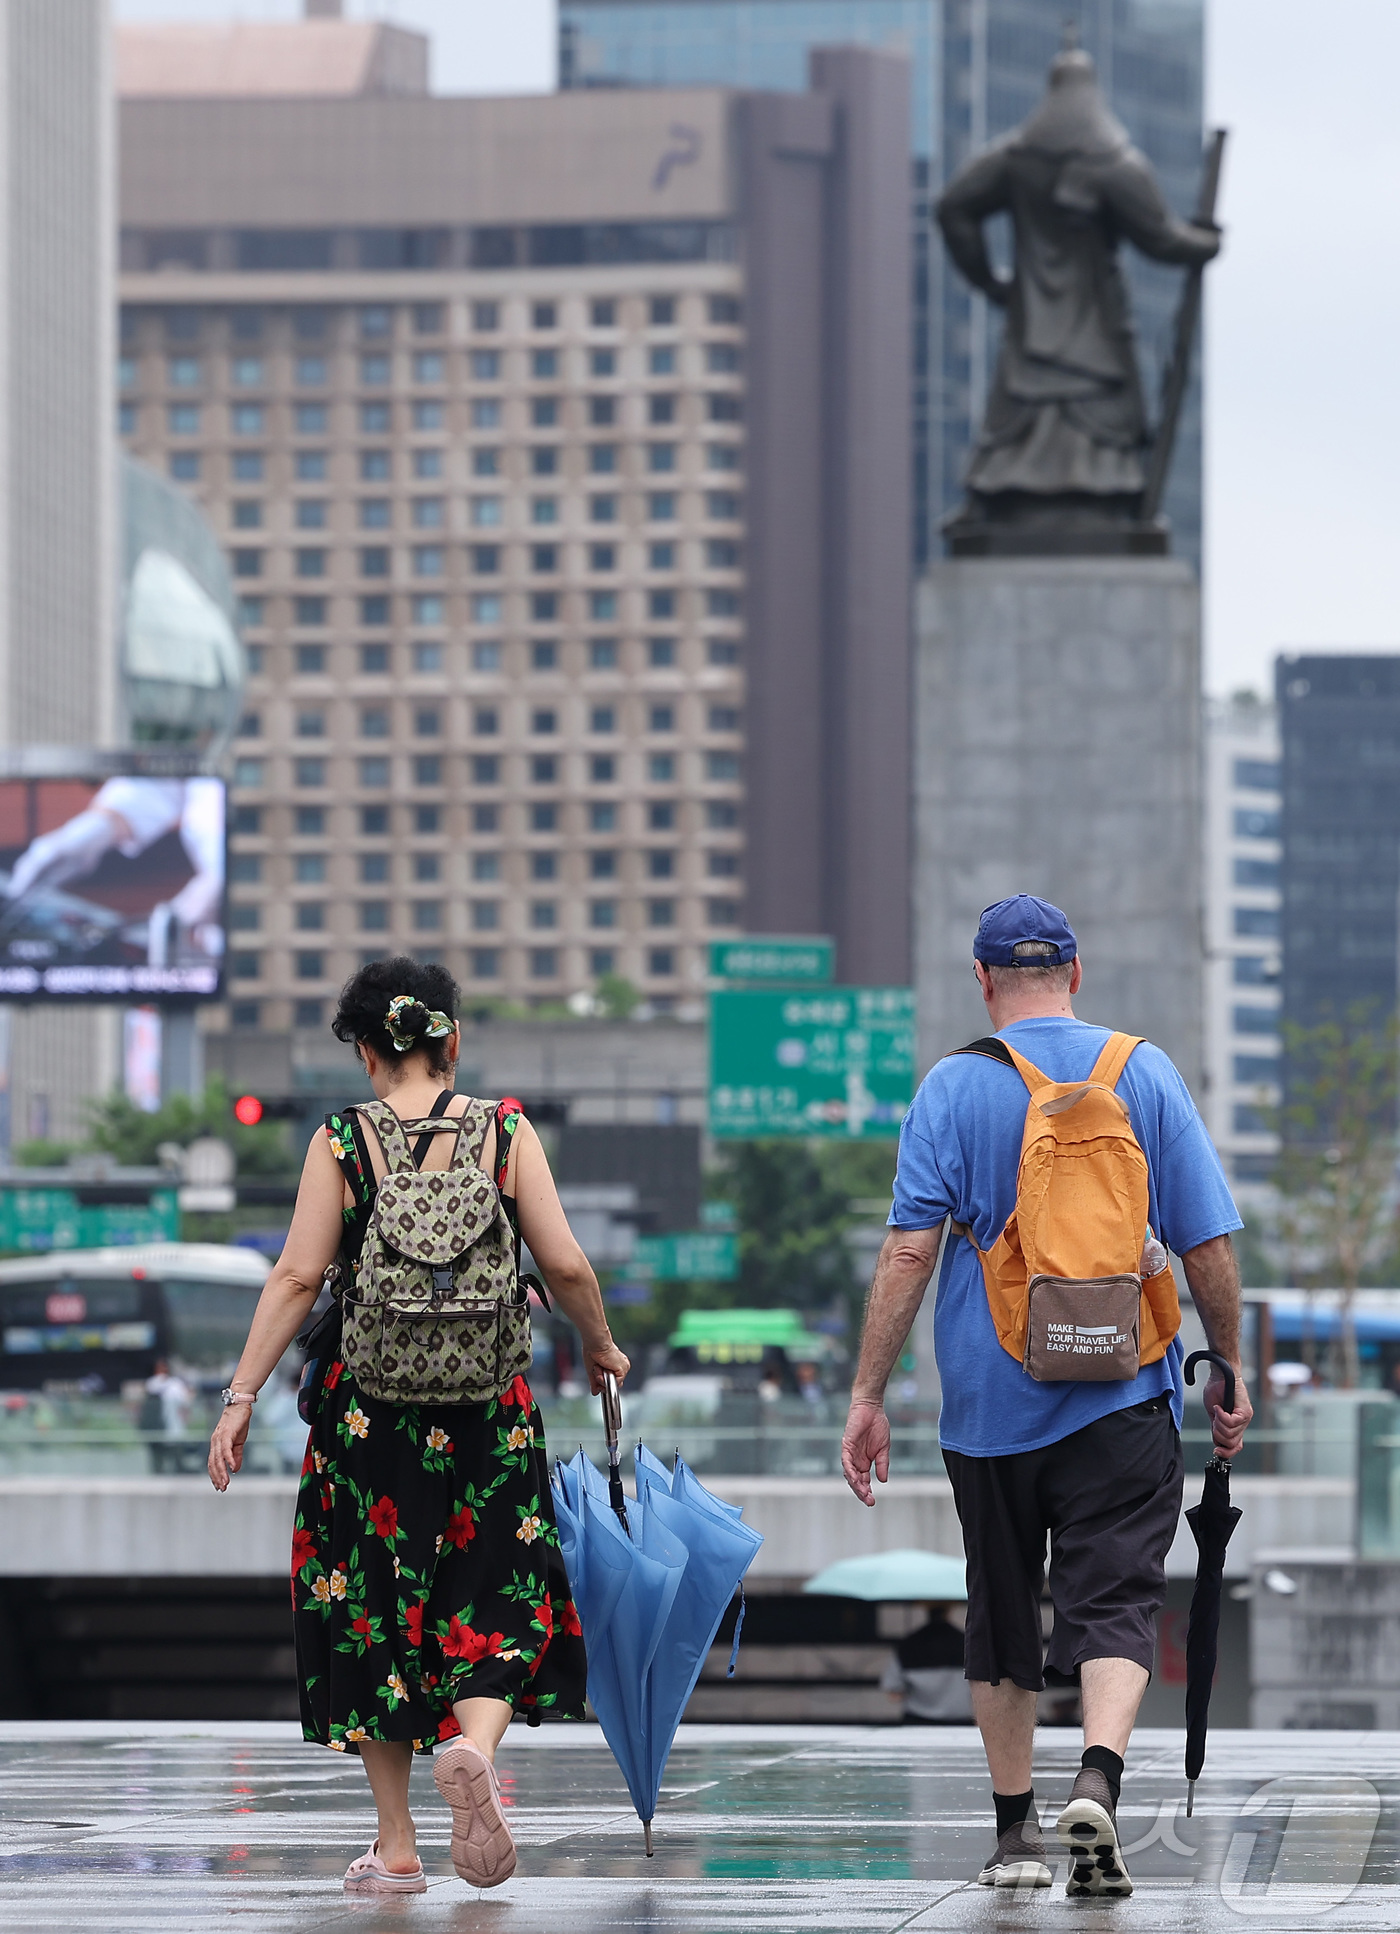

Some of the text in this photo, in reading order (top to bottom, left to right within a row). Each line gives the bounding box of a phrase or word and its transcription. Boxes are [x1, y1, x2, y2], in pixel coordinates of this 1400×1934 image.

[1047, 1323, 1074, 1333] MAKE
[1047, 1333, 1128, 1345] YOUR TRAVEL LIFE
[1046, 1342, 1114, 1355] EASY AND FUN
